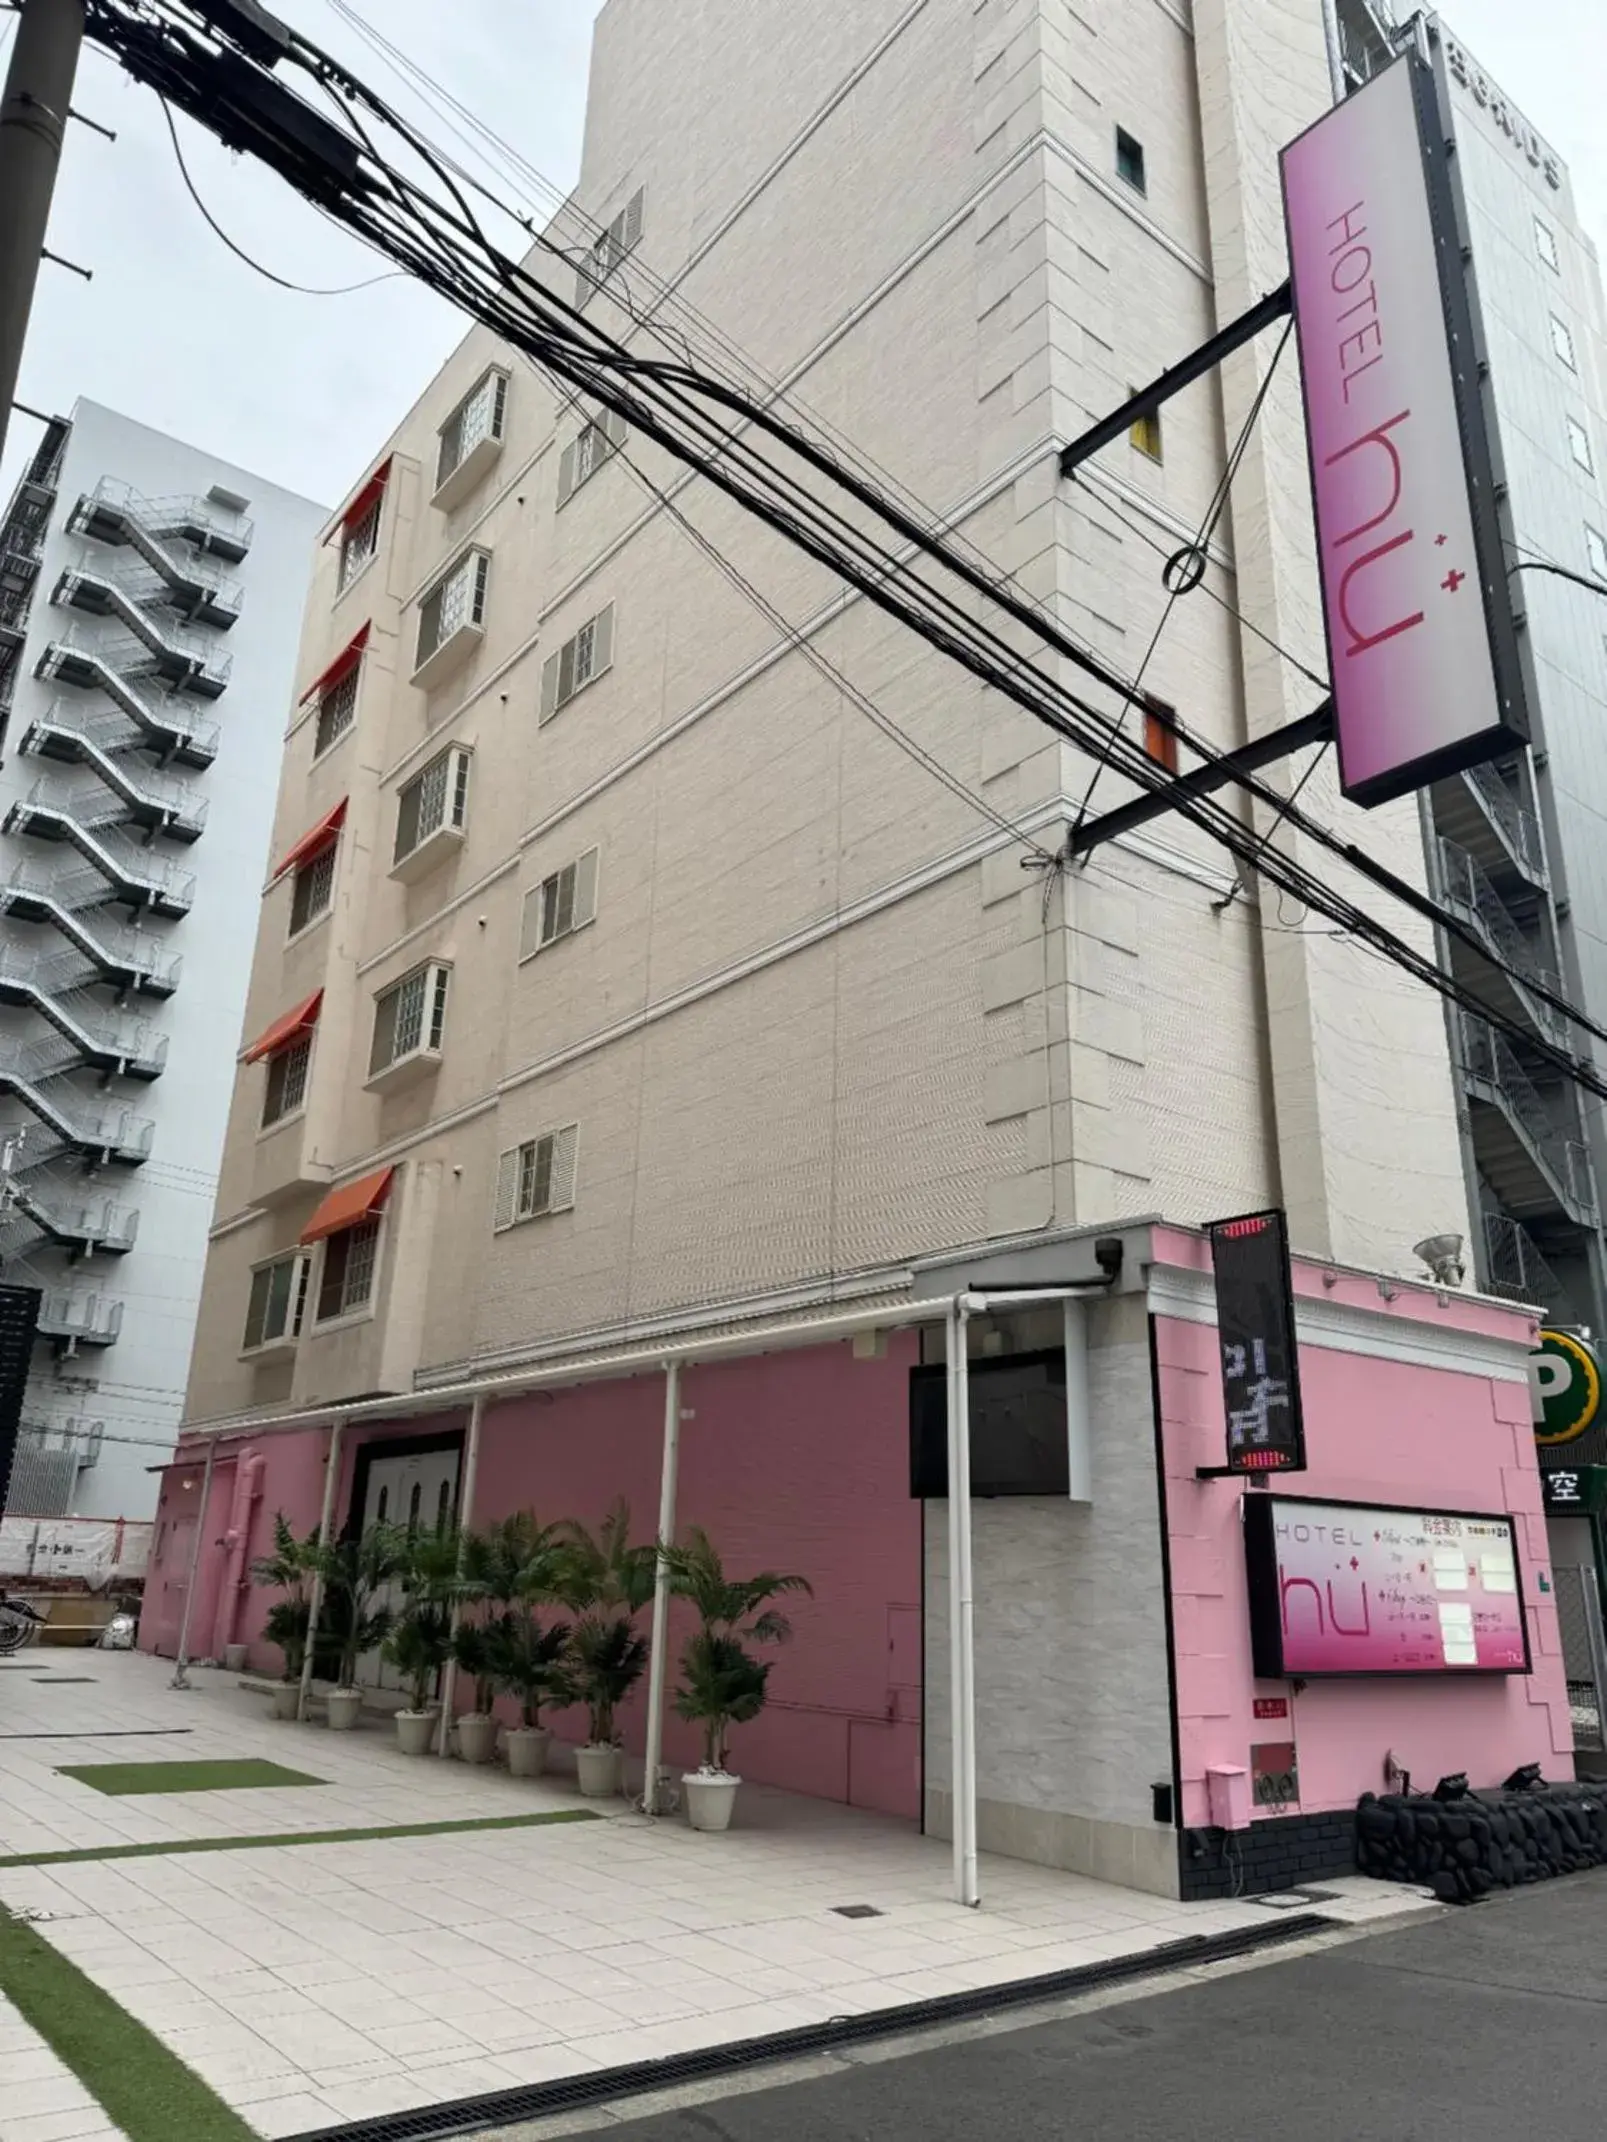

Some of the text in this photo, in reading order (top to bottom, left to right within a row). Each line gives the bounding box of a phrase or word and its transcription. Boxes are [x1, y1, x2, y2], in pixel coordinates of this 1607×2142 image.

[1326, 200, 1383, 404] HOTEL
[1528, 1353, 1573, 1423] P
[1547, 1470, 1582, 1502] 空
[1275, 1522, 1363, 1547] HOTEL
